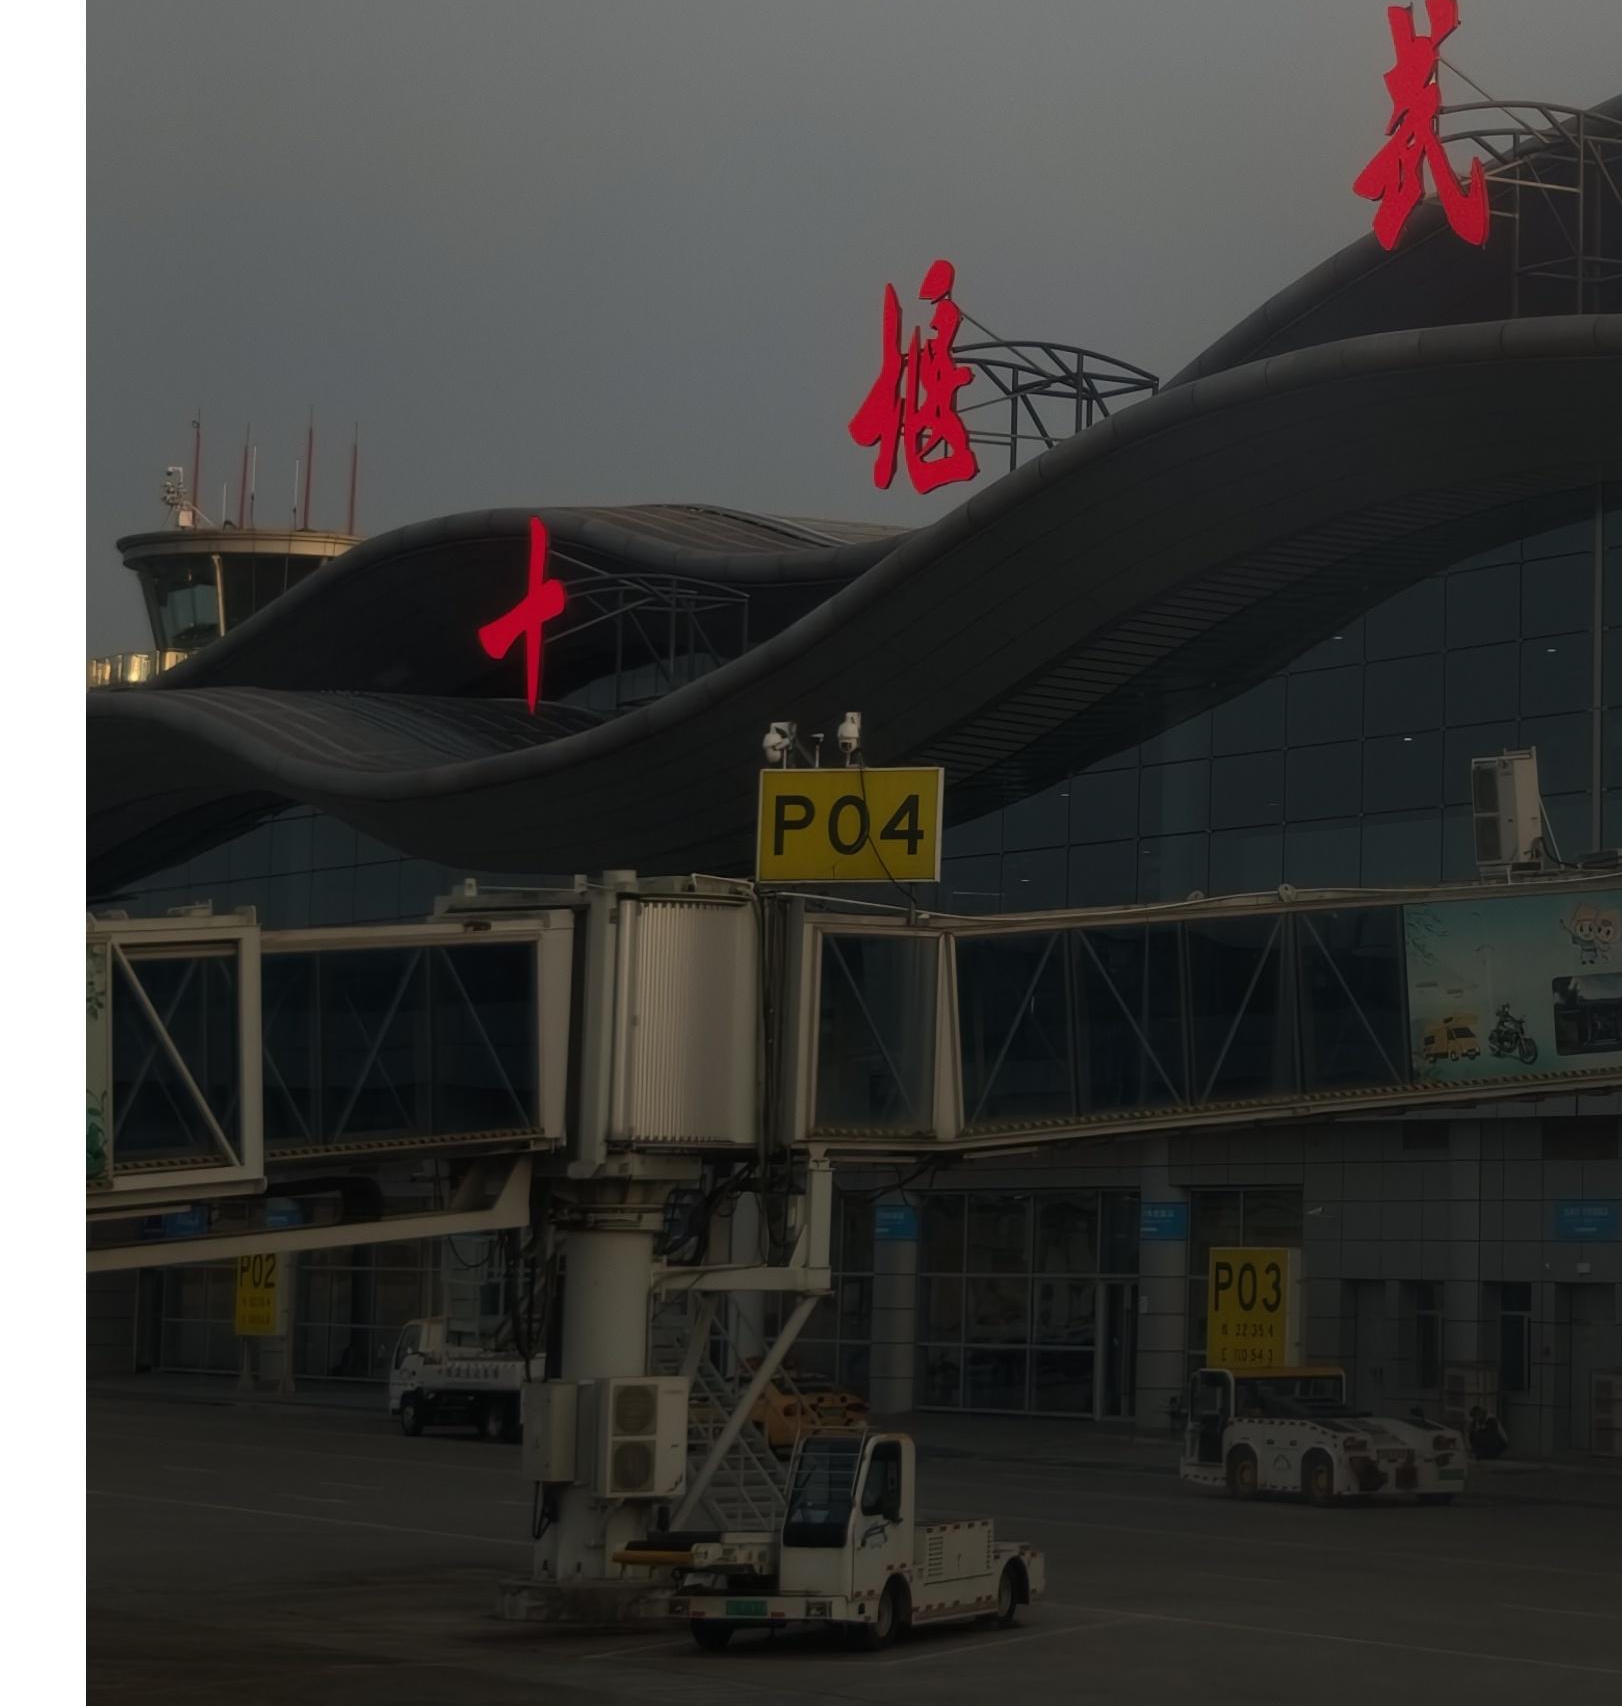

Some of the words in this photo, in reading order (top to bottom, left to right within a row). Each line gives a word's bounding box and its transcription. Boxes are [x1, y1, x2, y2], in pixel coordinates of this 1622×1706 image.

[477, 516, 566, 713] 十
[848, 259, 977, 494] 堰
[773, 794, 924, 856] P04
[239, 1253, 276, 1289] P02
[1214, 1261, 1281, 1312] P03
